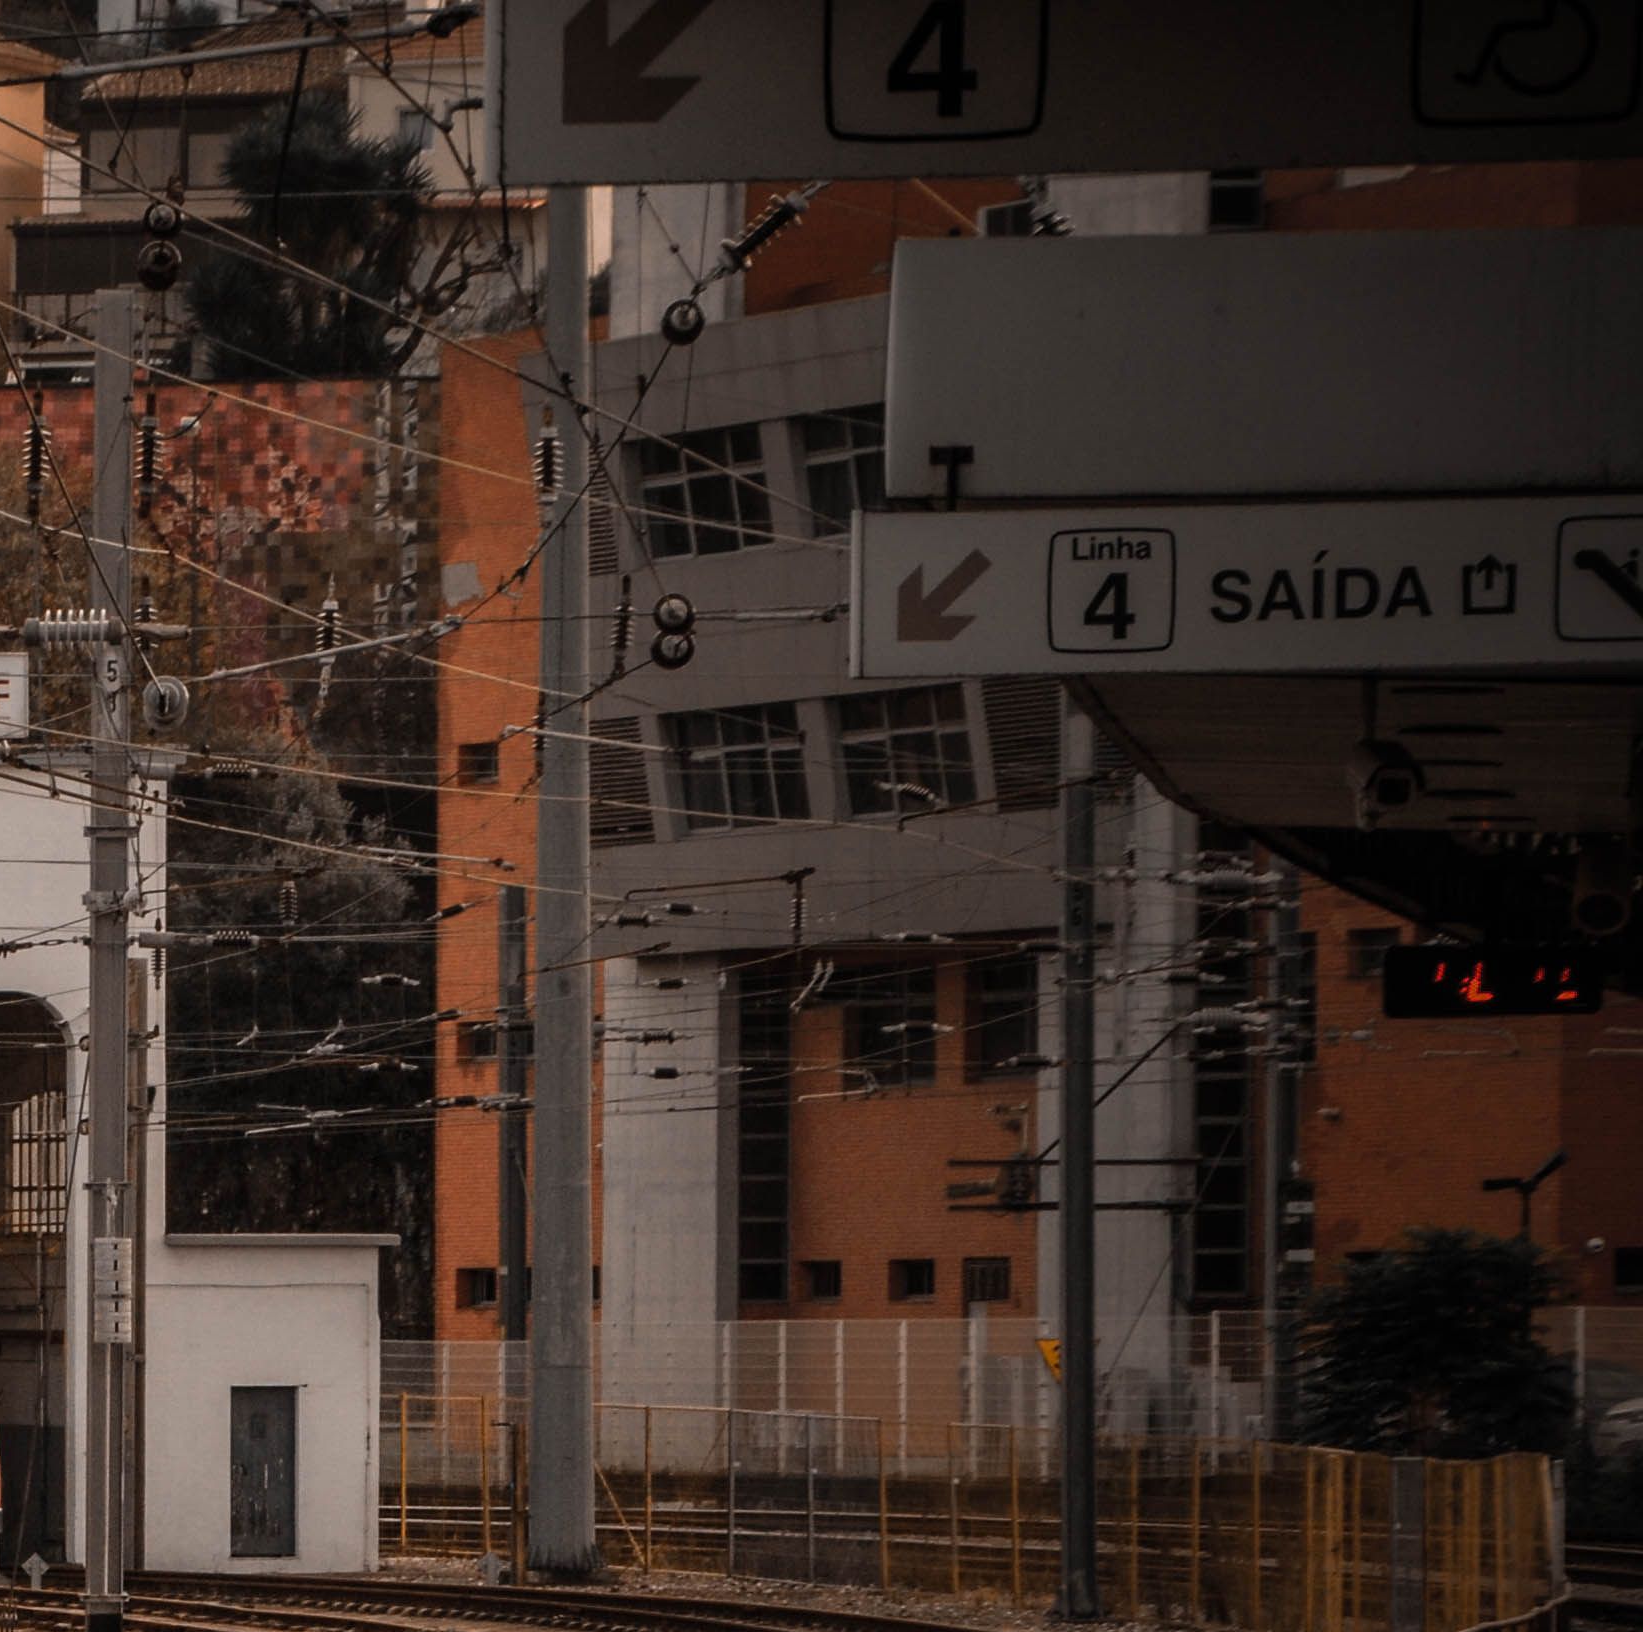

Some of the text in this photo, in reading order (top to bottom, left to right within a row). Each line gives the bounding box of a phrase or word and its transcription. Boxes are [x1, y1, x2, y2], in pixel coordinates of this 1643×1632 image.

[886, 0, 978, 118] 4
[1071, 537, 1152, 560] Linha
[1083, 550, 1433, 640] 4 SAÍDA
